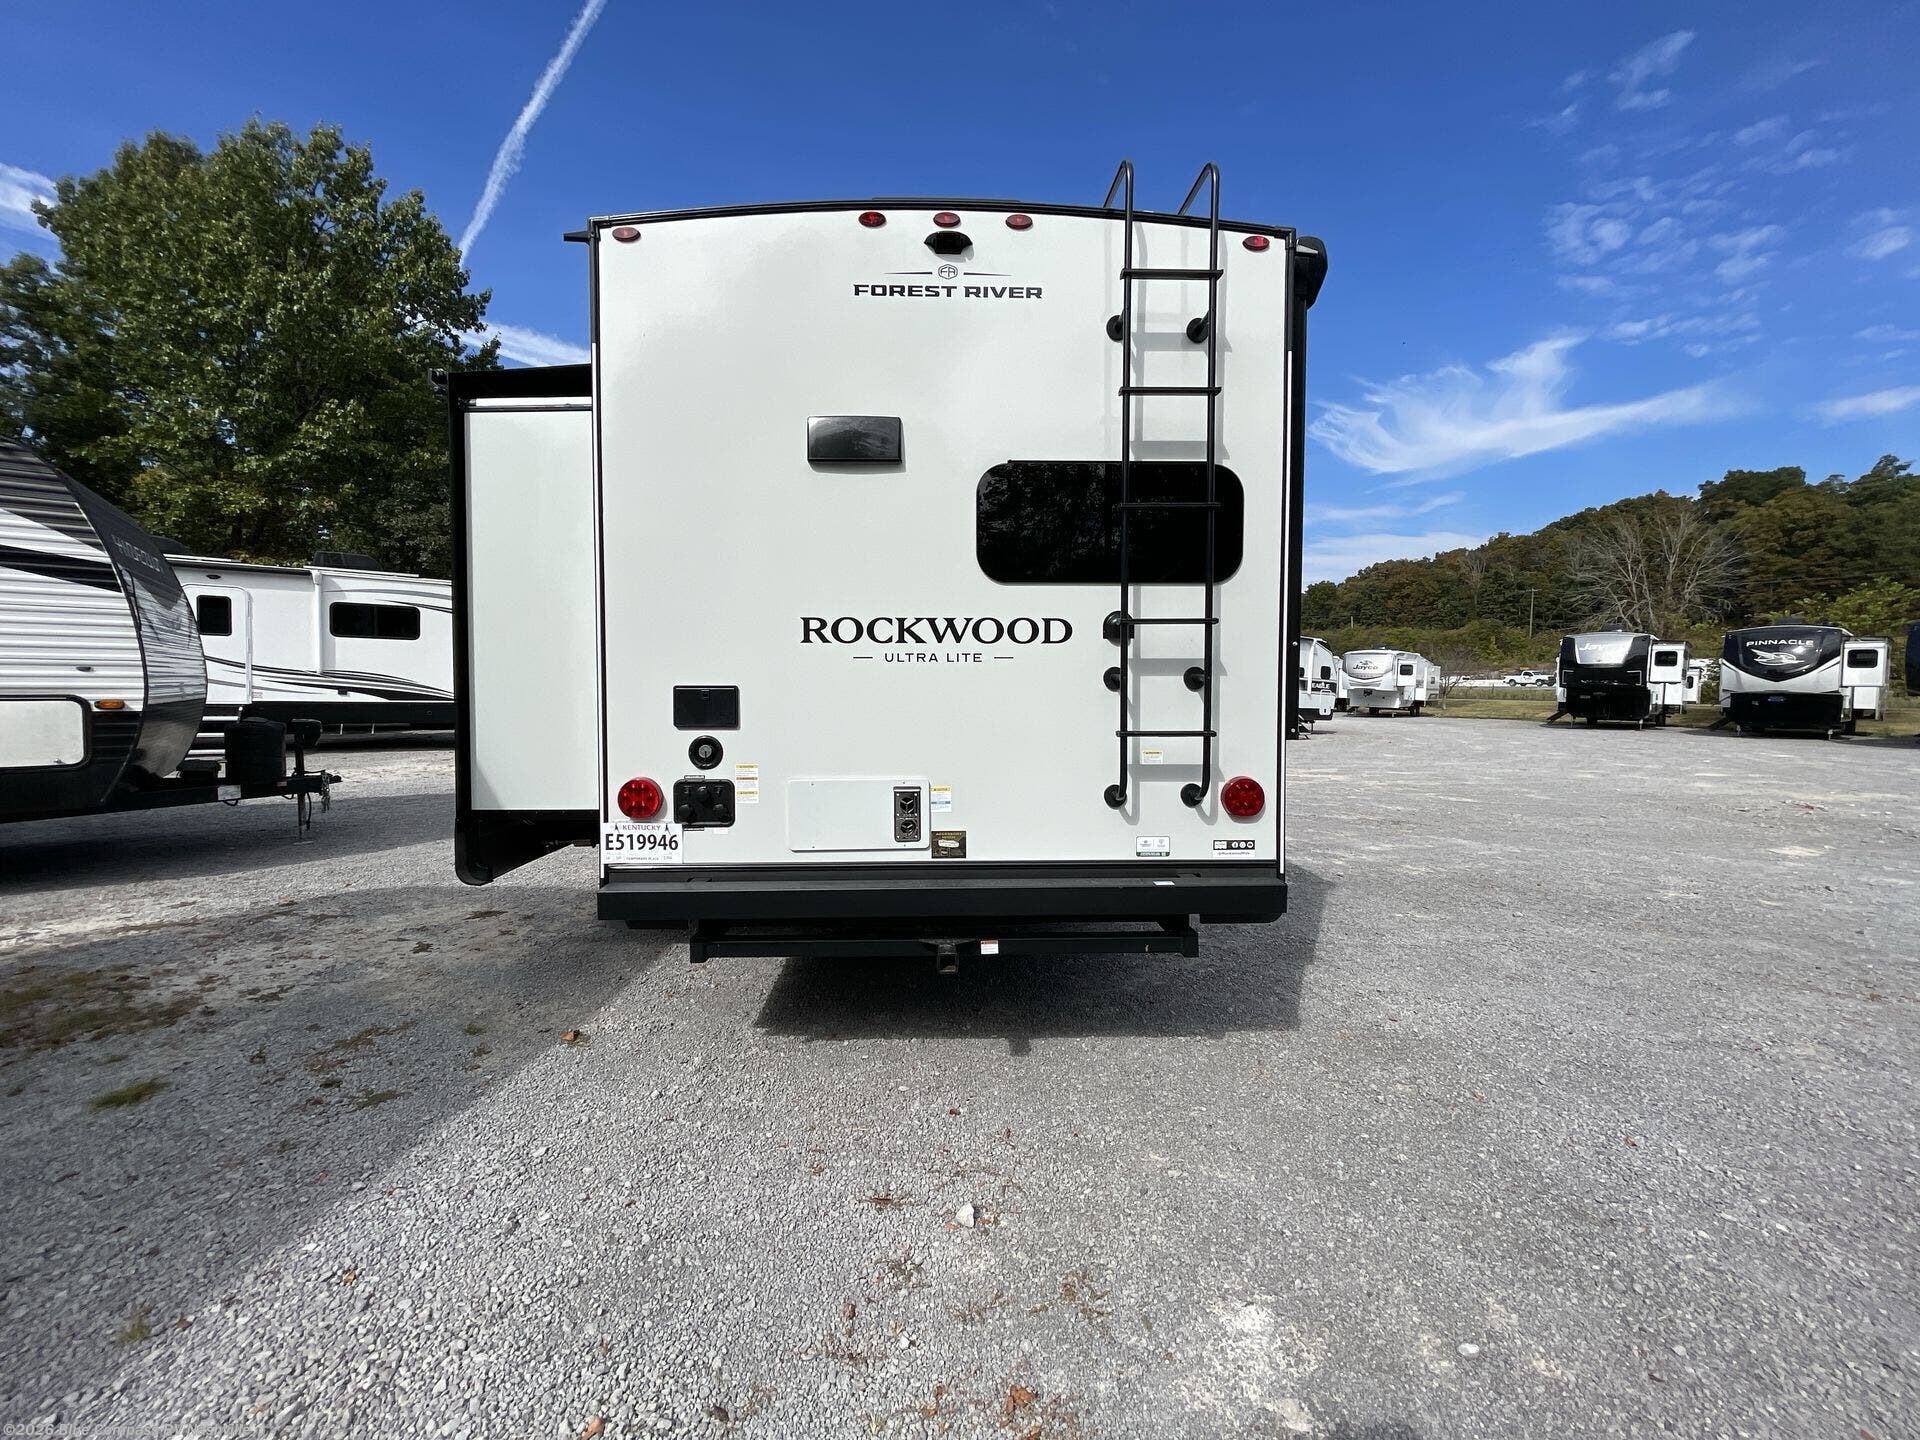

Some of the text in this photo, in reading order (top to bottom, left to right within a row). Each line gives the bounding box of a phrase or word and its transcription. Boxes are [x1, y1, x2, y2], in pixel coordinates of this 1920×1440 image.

[853, 284, 1043, 299] FOREST RIVER
[799, 616, 1073, 644] ROCKWOOD
[1746, 639, 1815, 647] PINNACLE
[884, 652, 983, 663] ULTRA LITE
[1352, 663, 1380, 671] Jayco
[605, 833, 679, 850] E519946
